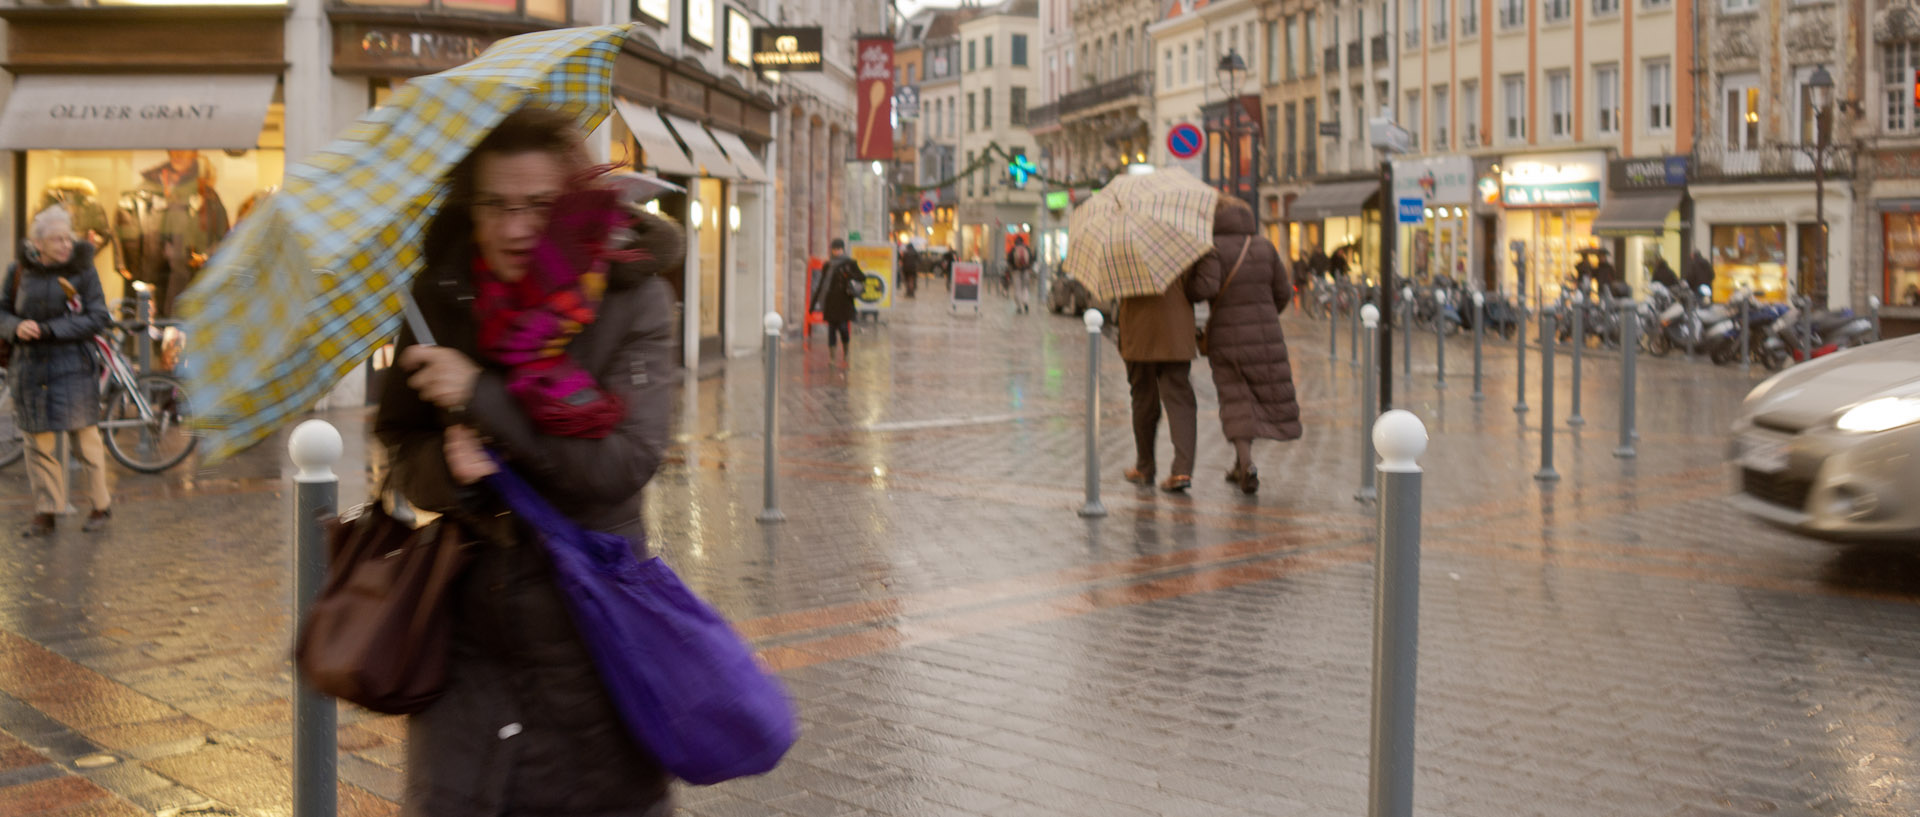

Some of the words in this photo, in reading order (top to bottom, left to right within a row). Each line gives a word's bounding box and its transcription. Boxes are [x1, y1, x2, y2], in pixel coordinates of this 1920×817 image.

[361, 30, 481, 58] OLIVER
[49, 104, 131, 120] OLIVER
[139, 104, 218, 120] GRANT
